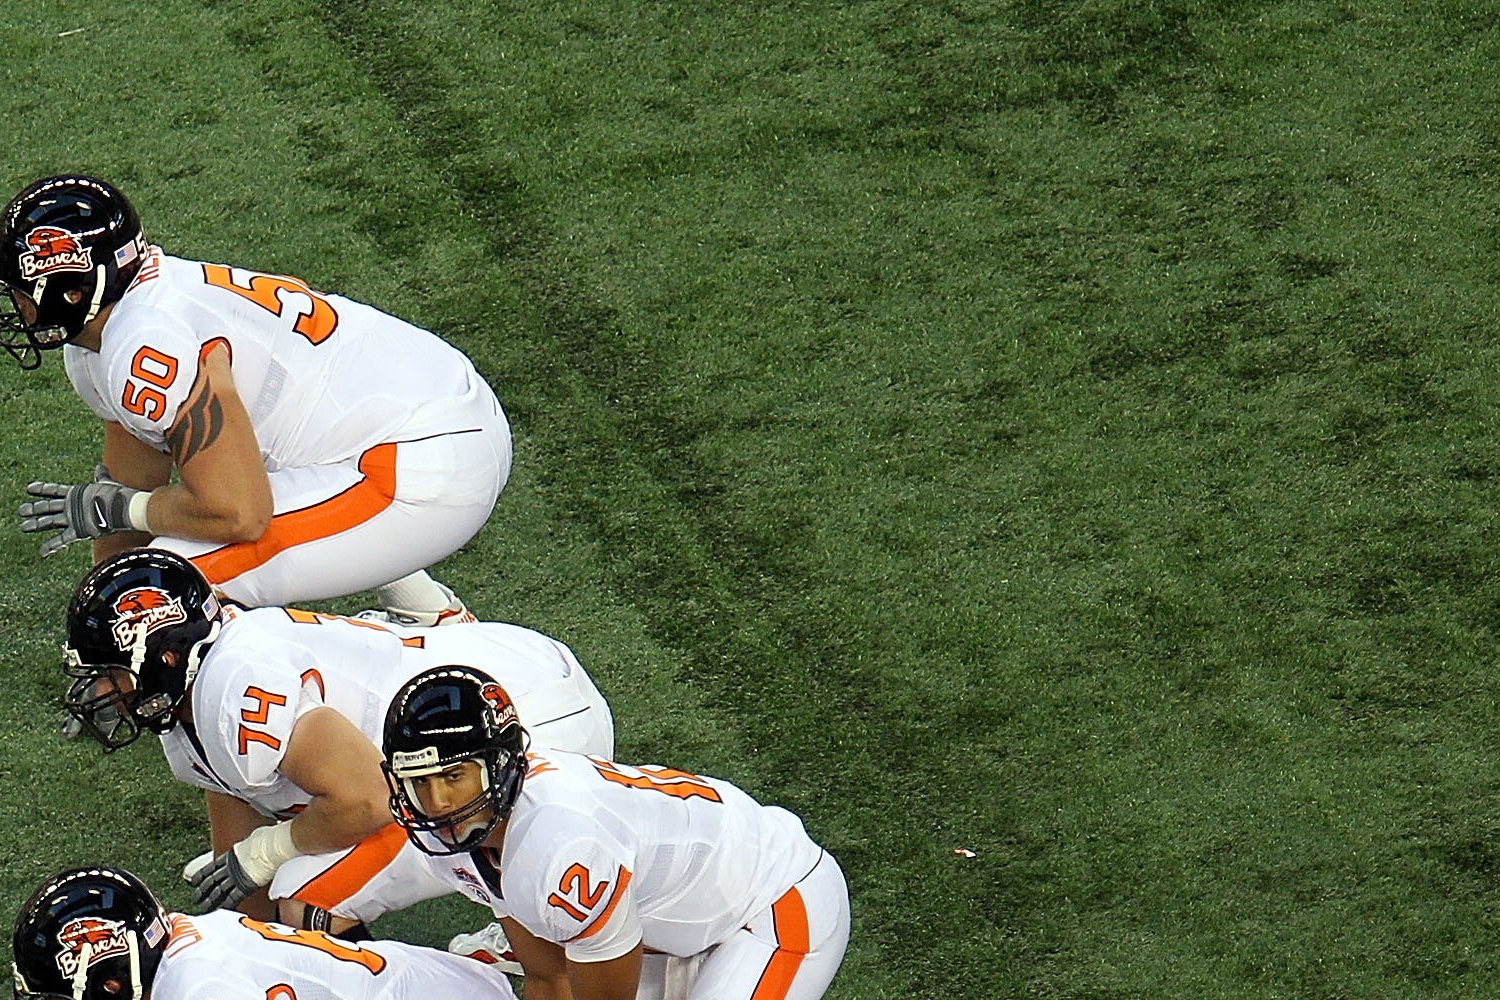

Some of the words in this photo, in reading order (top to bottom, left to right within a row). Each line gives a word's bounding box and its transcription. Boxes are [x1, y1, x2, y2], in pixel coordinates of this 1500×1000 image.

[21, 249, 89, 276] Beavers
[201, 263, 339, 346] 5
[122, 344, 179, 423] 50
[237, 684, 288, 757] 74
[546, 863, 609, 923] 12
